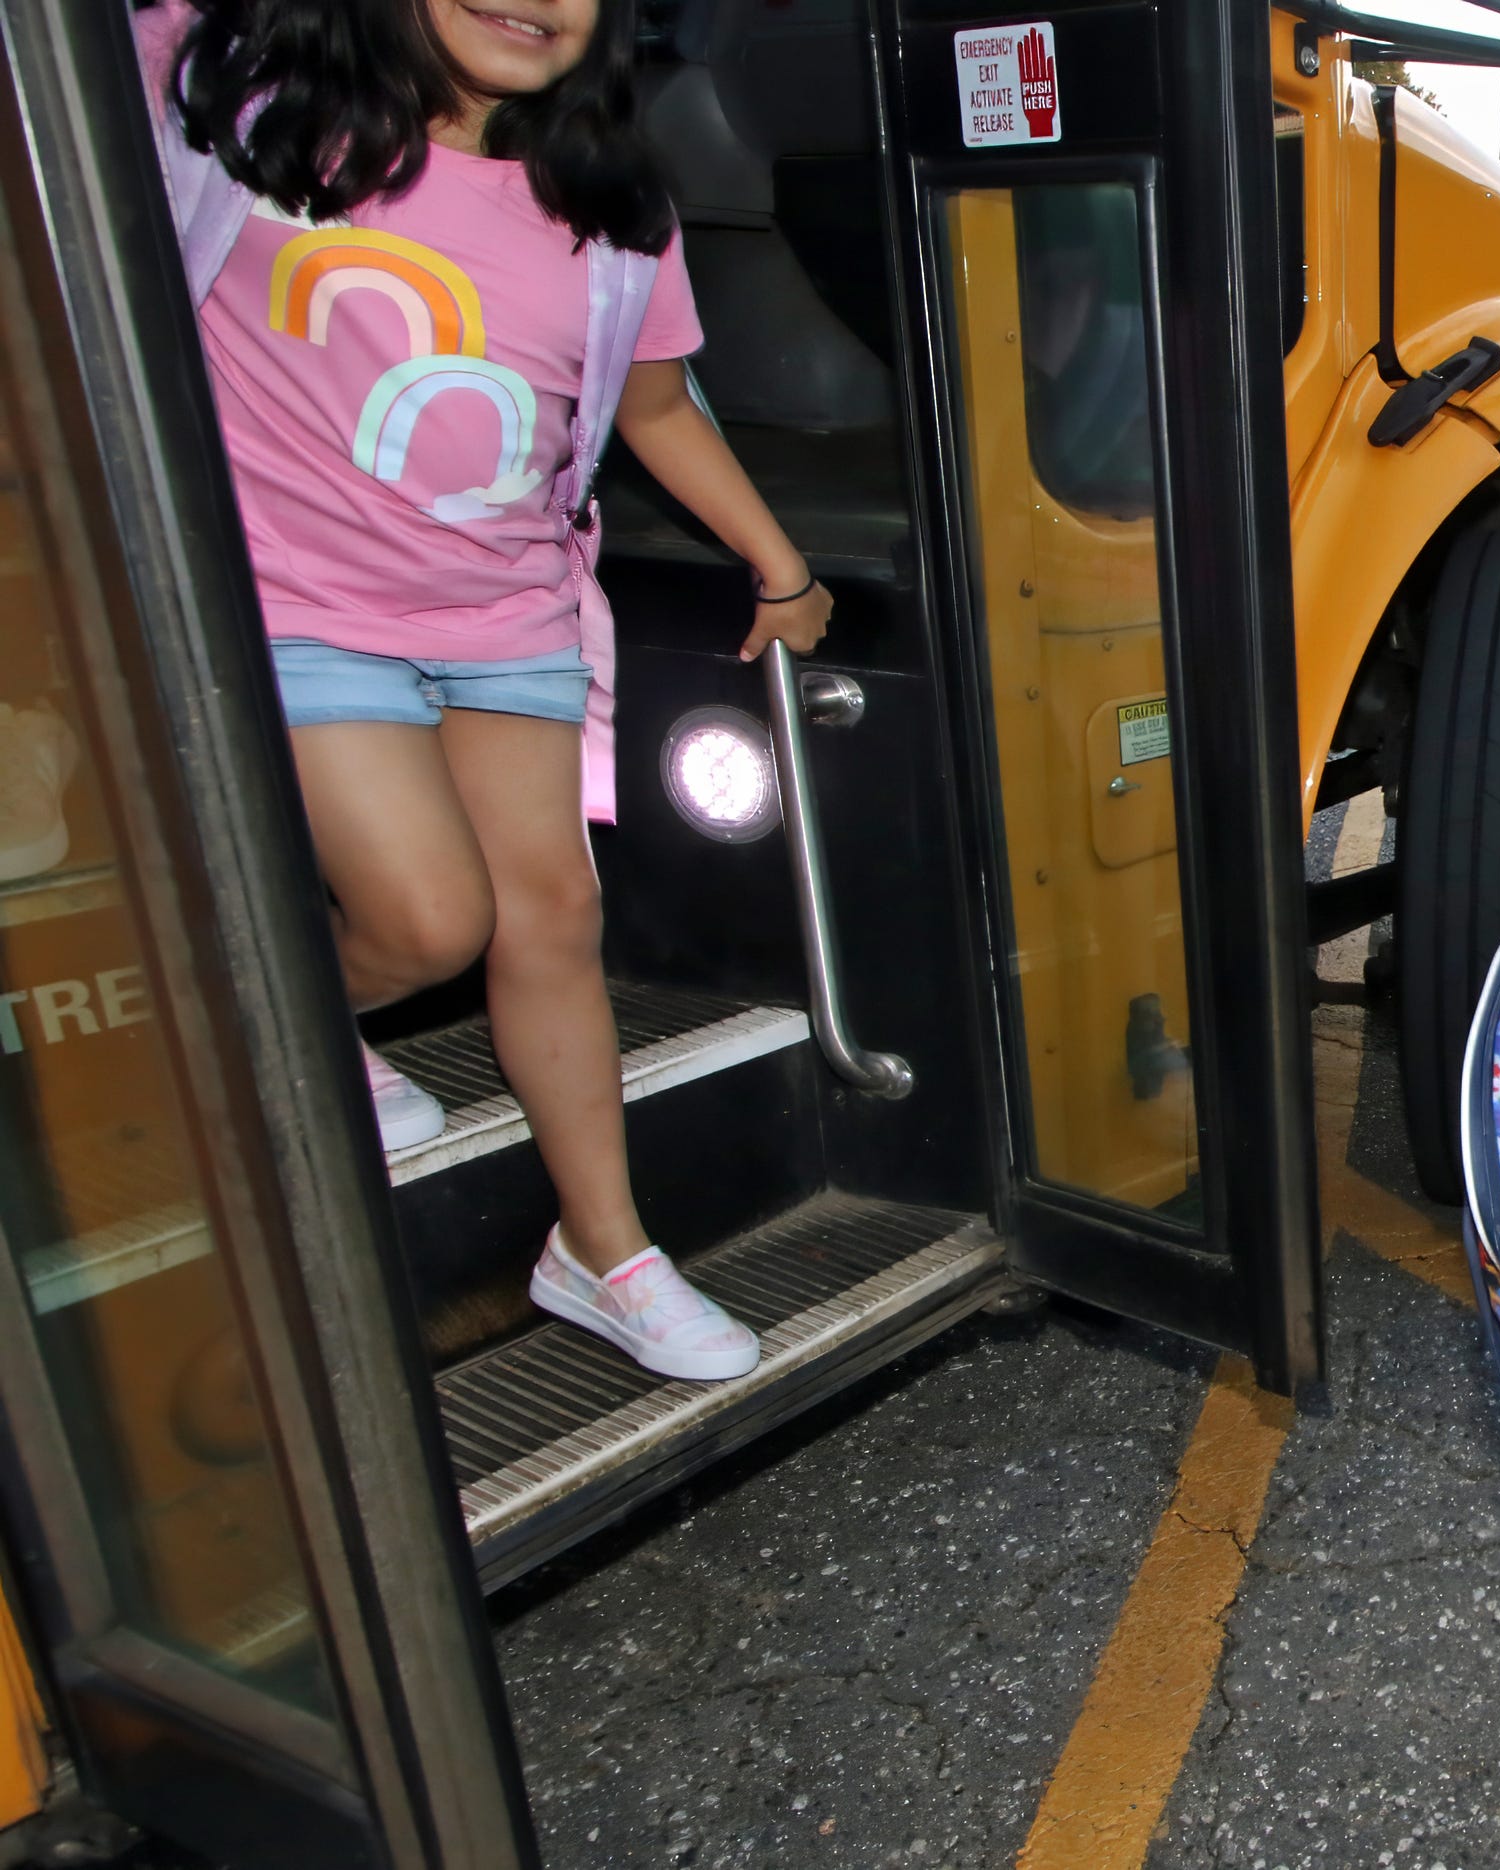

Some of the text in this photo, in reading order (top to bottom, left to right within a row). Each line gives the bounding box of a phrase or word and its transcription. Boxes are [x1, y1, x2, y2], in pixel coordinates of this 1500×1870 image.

[960, 38, 1013, 59] EMERGENCY
[979, 64, 998, 82] EXIT
[1022, 80, 1052, 95] PUSH
[971, 88, 1013, 108] ACTIVATE
[1024, 96, 1053, 109] HERE
[973, 114, 1014, 132] RELEASE
[1125, 703, 1167, 720] CAUTIO
